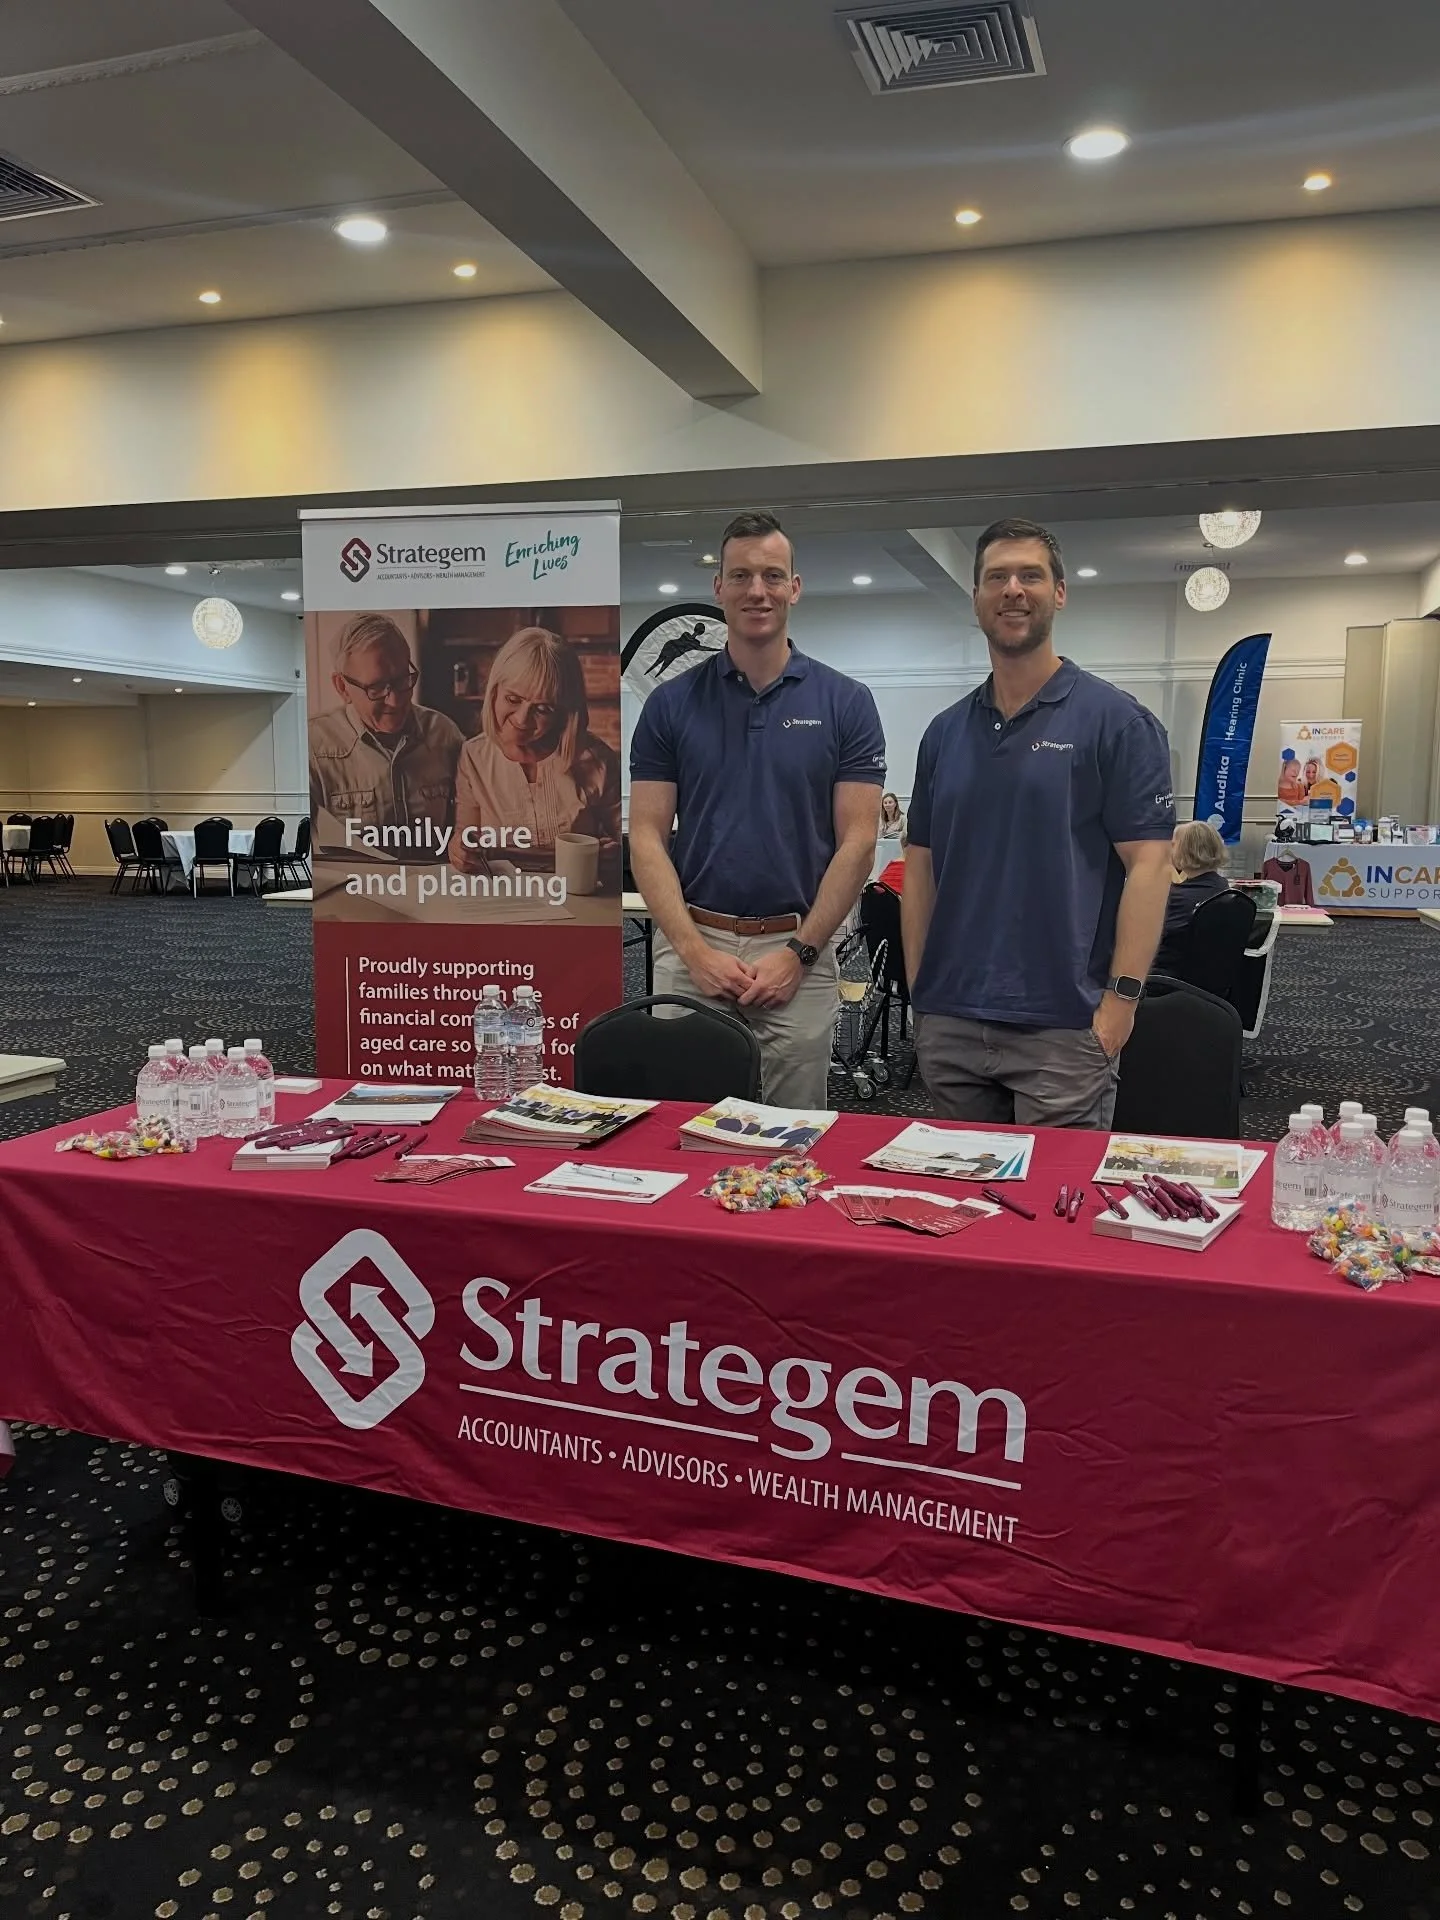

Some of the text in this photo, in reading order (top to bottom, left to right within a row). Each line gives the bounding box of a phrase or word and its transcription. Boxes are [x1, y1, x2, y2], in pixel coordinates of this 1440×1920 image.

[376, 543, 486, 569] Strategem
[505, 530, 581, 567] Enriching
[533, 554, 568, 580] Lives
[1214, 662, 1248, 812] Audika Hearing Clinic
[1312, 727, 1345, 735] INCARE
[1041, 740, 1074, 750] Strategem
[345, 817, 532, 856] Family care
[345, 866, 567, 905] and planning
[359, 957, 534, 981] Proudly supporting
[359, 982, 429, 1000] families
[512, 986, 542, 1003] te
[359, 1008, 435, 1026] financial
[560, 1012, 579, 1029] of
[360, 1035, 404, 1055] aged
[409, 1039, 447, 1053] care
[451, 1040, 472, 1053] so
[360, 1062, 383, 1076] on
[388, 1061, 432, 1078] what
[1389, 1200, 1432, 1212] Strategem
[459, 1276, 1027, 1464] Strategem
[457, 1414, 1019, 1545] ACCOUNTANTS ADVISORS WEALTH MANAGEMENT
